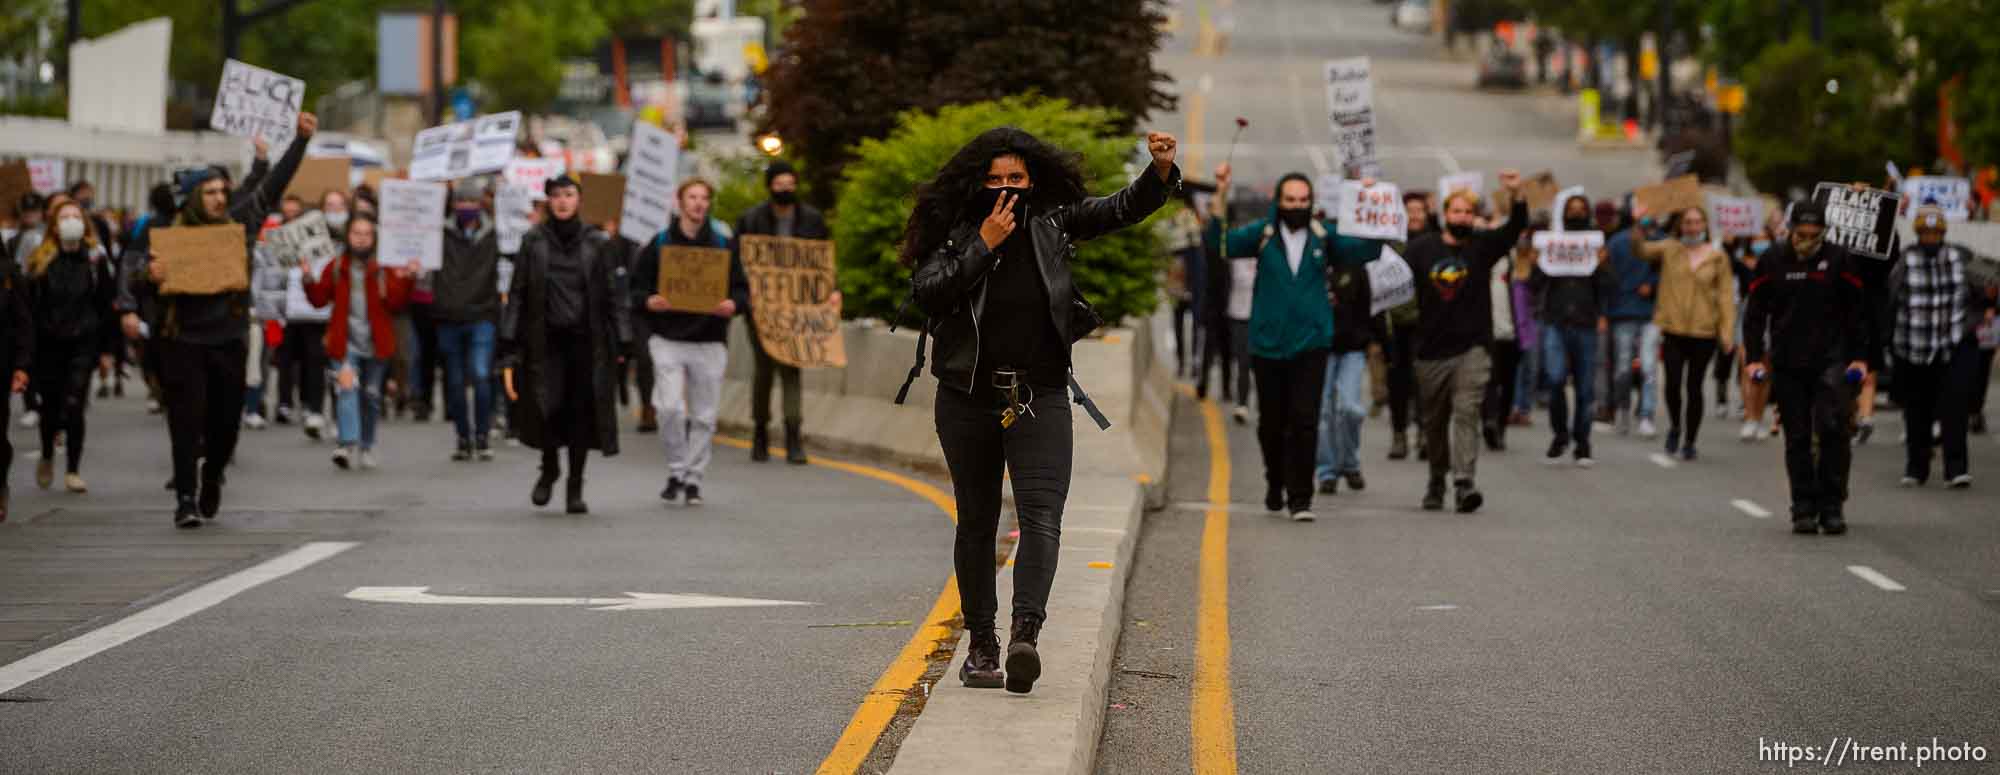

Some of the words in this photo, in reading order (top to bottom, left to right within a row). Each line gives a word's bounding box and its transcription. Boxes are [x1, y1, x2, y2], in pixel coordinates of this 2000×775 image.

[223, 69, 298, 113] BLACK
[1828, 187, 1883, 211] BLACK
[750, 270, 833, 304] DEFUND
